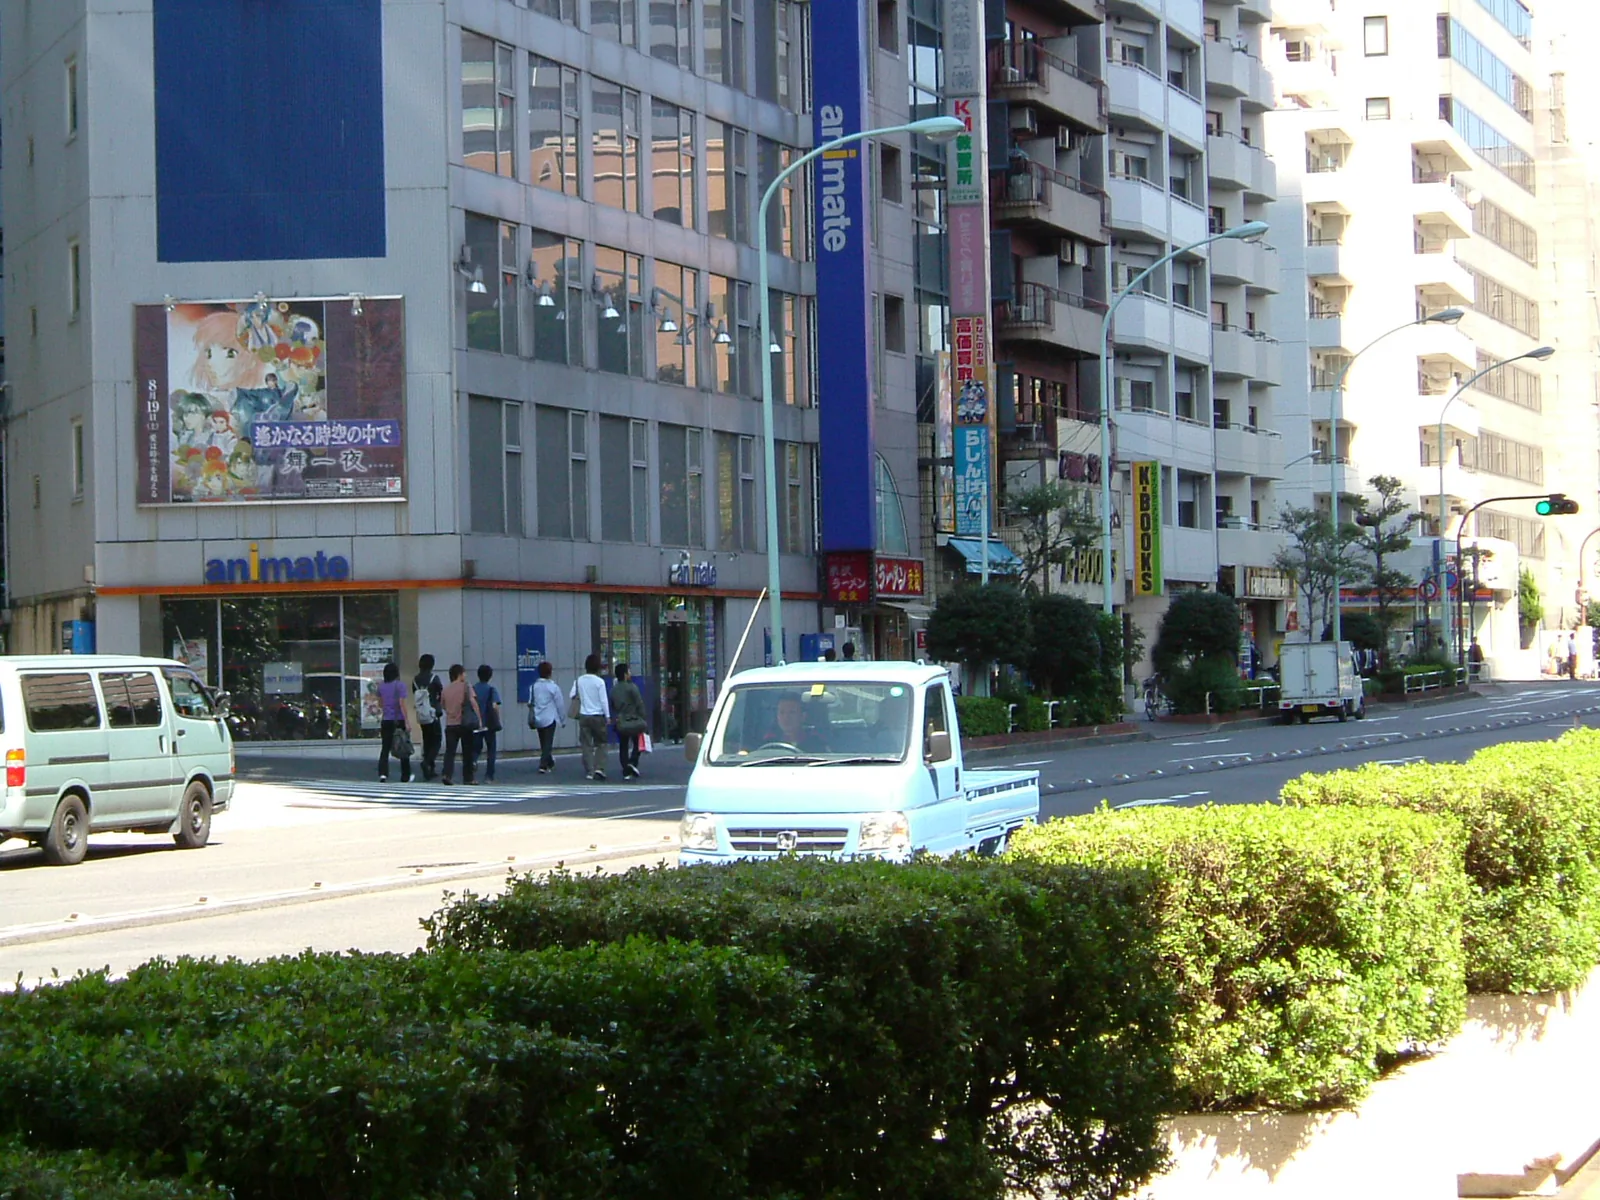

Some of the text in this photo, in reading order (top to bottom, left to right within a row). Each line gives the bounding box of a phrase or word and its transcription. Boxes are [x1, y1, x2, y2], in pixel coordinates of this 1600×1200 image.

[820, 104, 857, 252] animate
[205, 542, 350, 583] animate
[831, 577, 866, 590] ラーメン
